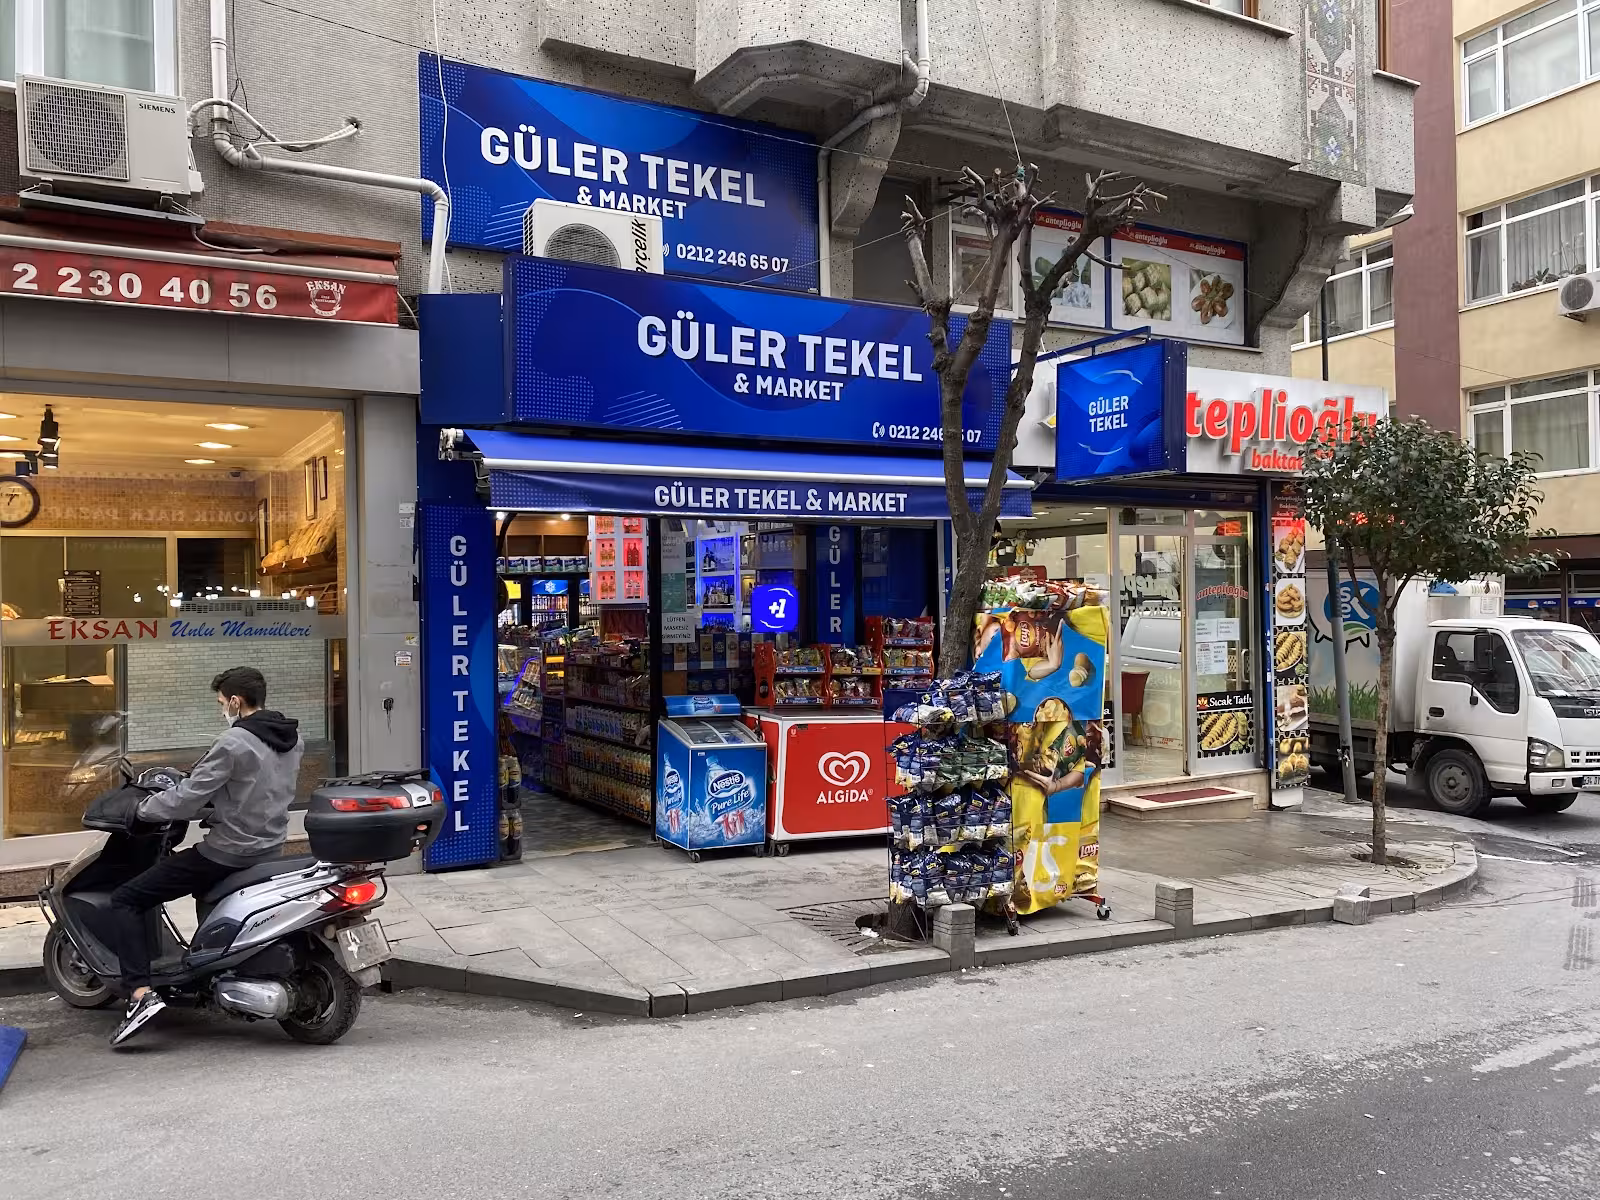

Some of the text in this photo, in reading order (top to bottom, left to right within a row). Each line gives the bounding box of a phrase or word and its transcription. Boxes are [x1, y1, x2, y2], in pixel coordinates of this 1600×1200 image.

[139, 103, 176, 114] SIEMENS
[481, 124, 766, 208] GÜLER TEKEL
[577, 186, 687, 220] & MARKET
[676, 243, 789, 273] 0212 246 65 07
[12, 262, 278, 310] 2 230 40 56
[305, 280, 347, 294] EKSAN
[637, 310, 923, 382] GÜLER TEKEL
[734, 373, 844, 401] & MARKET
[1088, 395, 1130, 417] GÜLER
[889, 424, 920, 440] 0212
[966, 429, 982, 443] 07
[1089, 412, 1128, 433] TEKEL
[654, 481, 908, 513] GÜLER TEKEL & MARKET
[829, 526, 841, 632] GÜLER
[48, 620, 312, 640] EKSAN Unlu Mamülleri
[450, 535, 470, 832] GÜLER TEKEL
[1209, 696, 1233, 707] Sıcak
[711, 789, 749, 814] Pure Life
